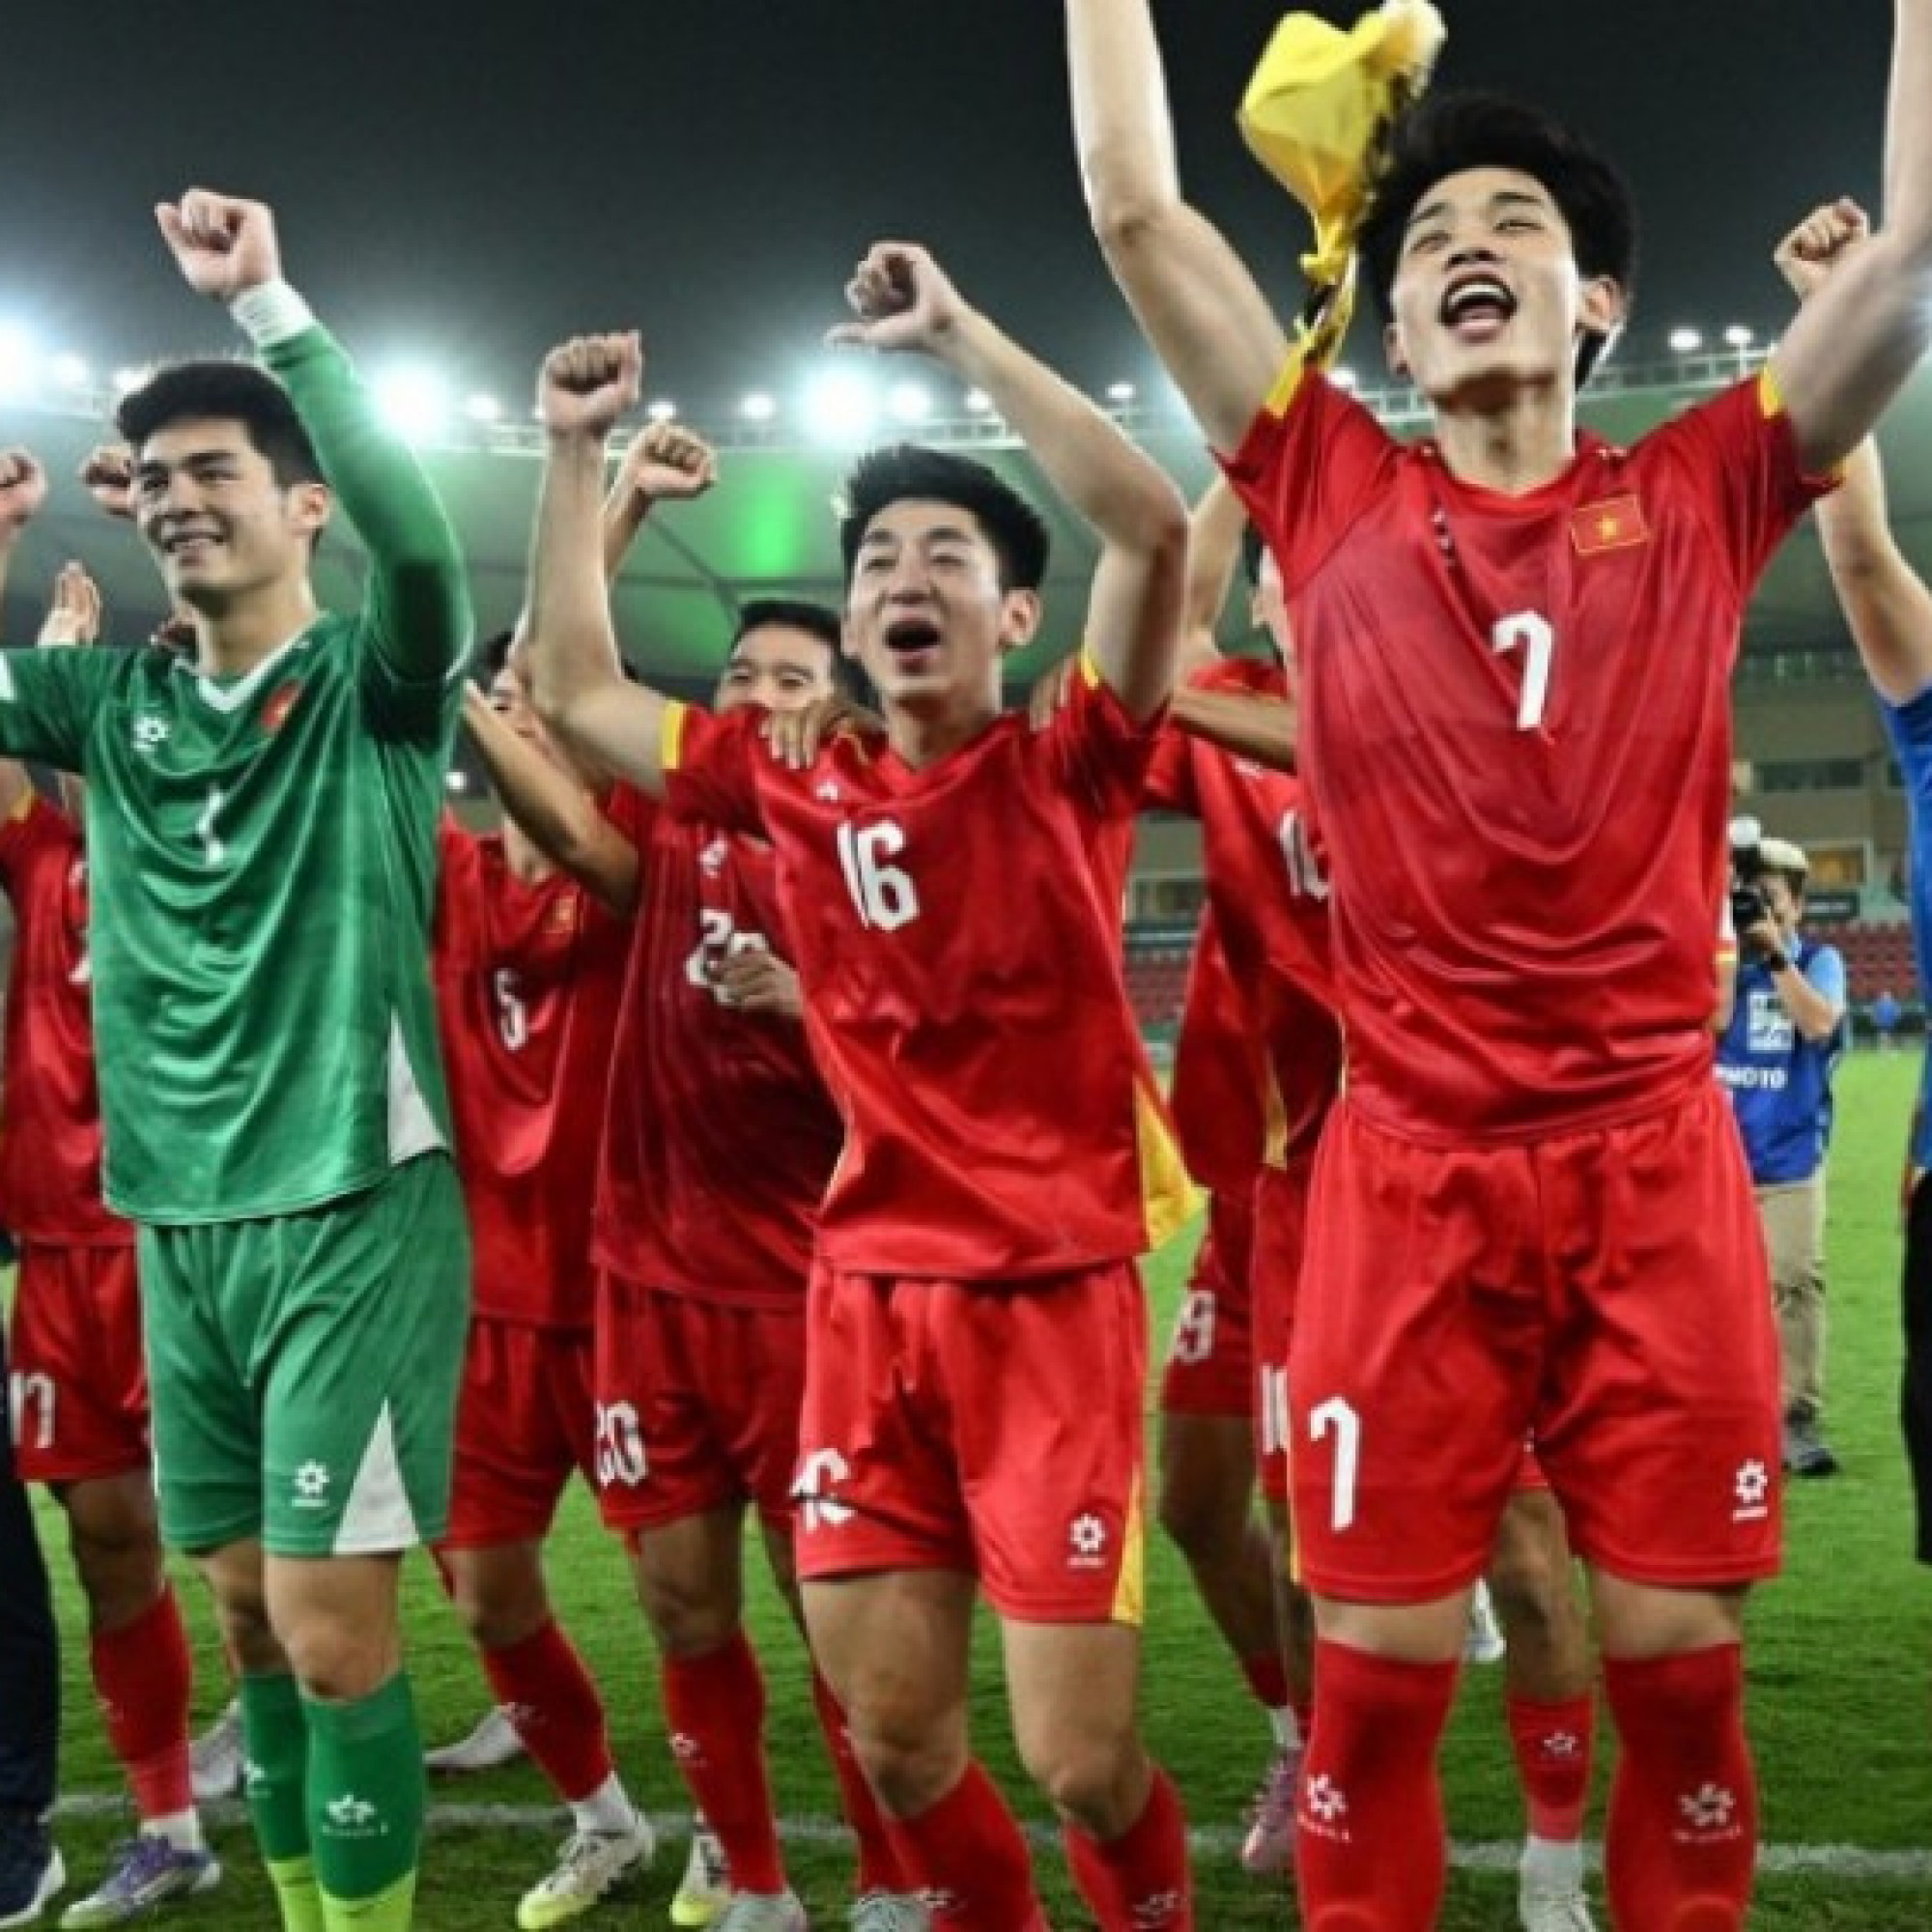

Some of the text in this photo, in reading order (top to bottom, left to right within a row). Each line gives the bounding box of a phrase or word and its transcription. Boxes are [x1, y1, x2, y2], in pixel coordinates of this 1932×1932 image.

[1492, 610, 1552, 730] 7
[837, 820, 920, 931] 16
[1309, 1397, 1359, 1531] 7
